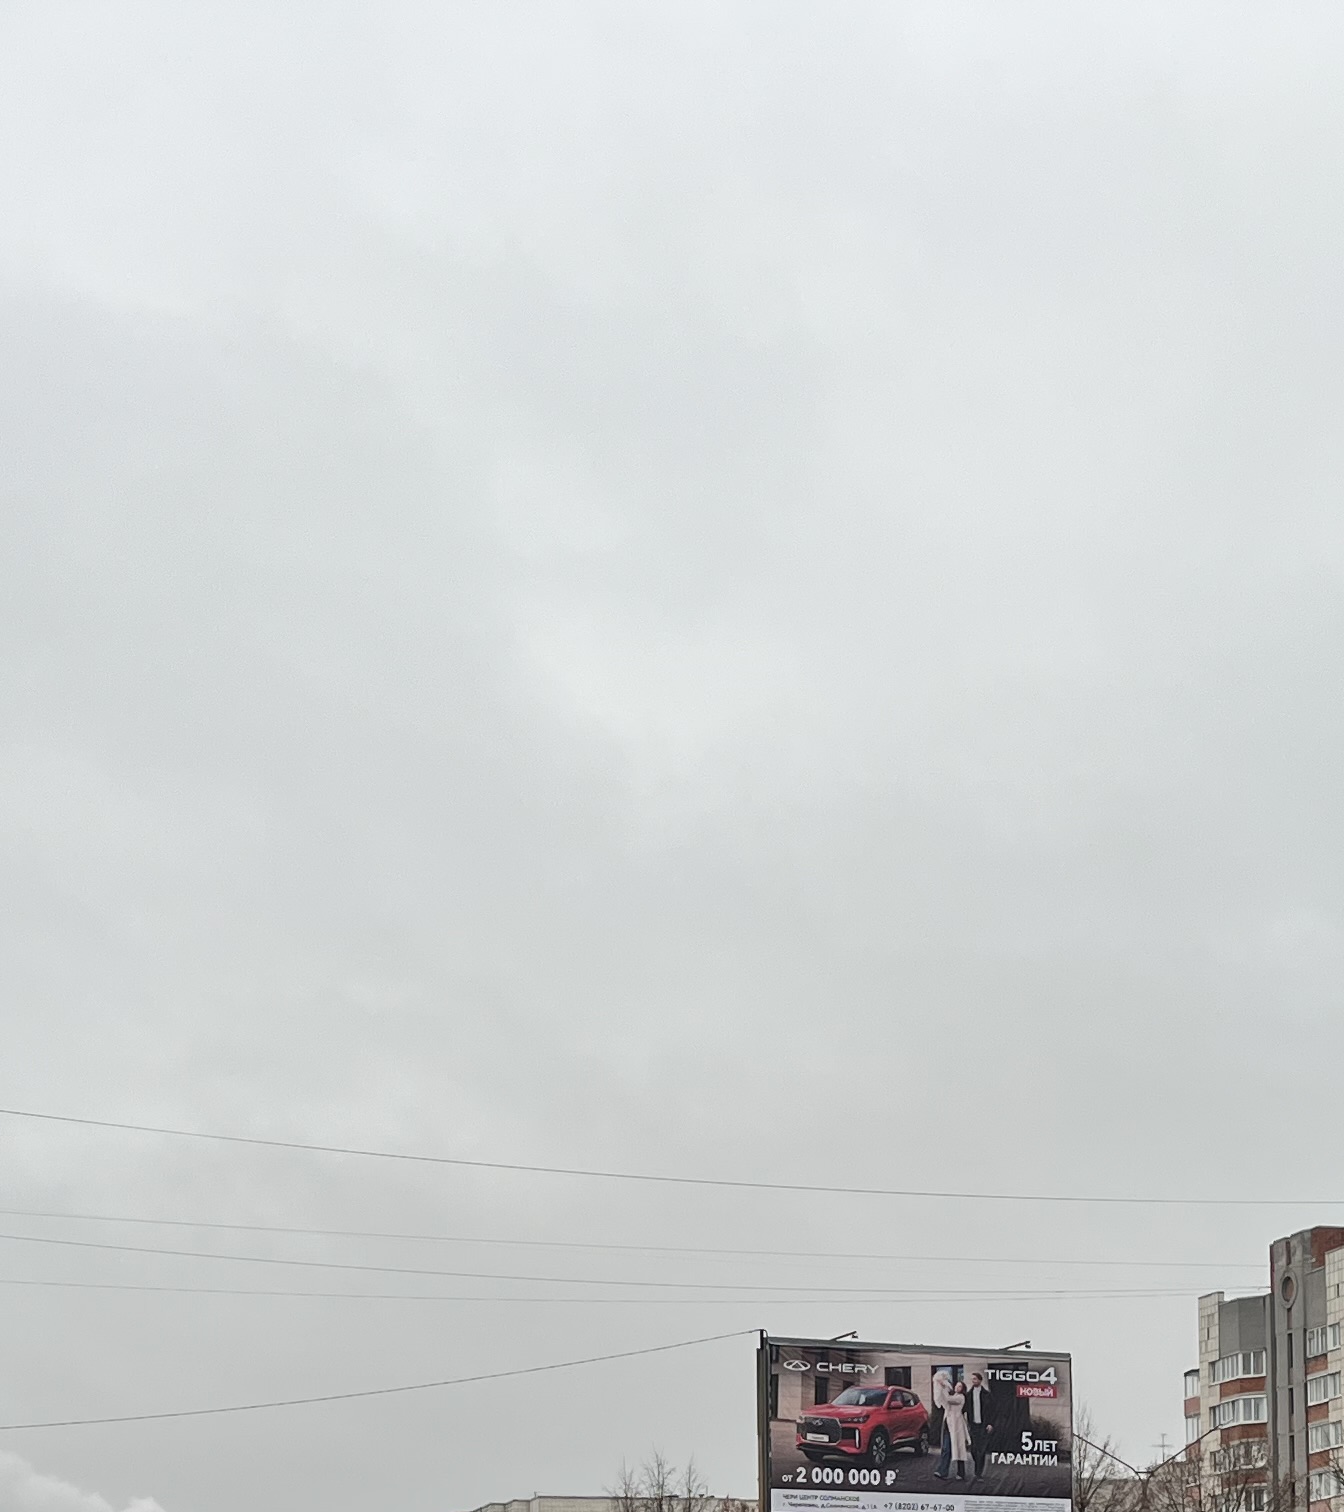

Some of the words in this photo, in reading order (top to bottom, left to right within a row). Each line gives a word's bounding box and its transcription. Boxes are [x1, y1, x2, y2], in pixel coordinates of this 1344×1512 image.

[816, 1362, 879, 1374] CHERY
[1019, 1387, 1054, 1397] НОВЫЙ
[1021, 1431, 1033, 1452] 5
[1033, 1440, 1058, 1452] ЛЕТ
[991, 1452, 1058, 1467] ГАРАНТИИ
[796, 1466, 807, 1483] 2
[811, 1467, 844, 1484] 000
[848, 1469, 880, 1486] 000
[883, 1502, 894, 1510] +7
[894, 1502, 919, 1511] (8202)
[920, 1503, 955, 1512] 67-67-00
